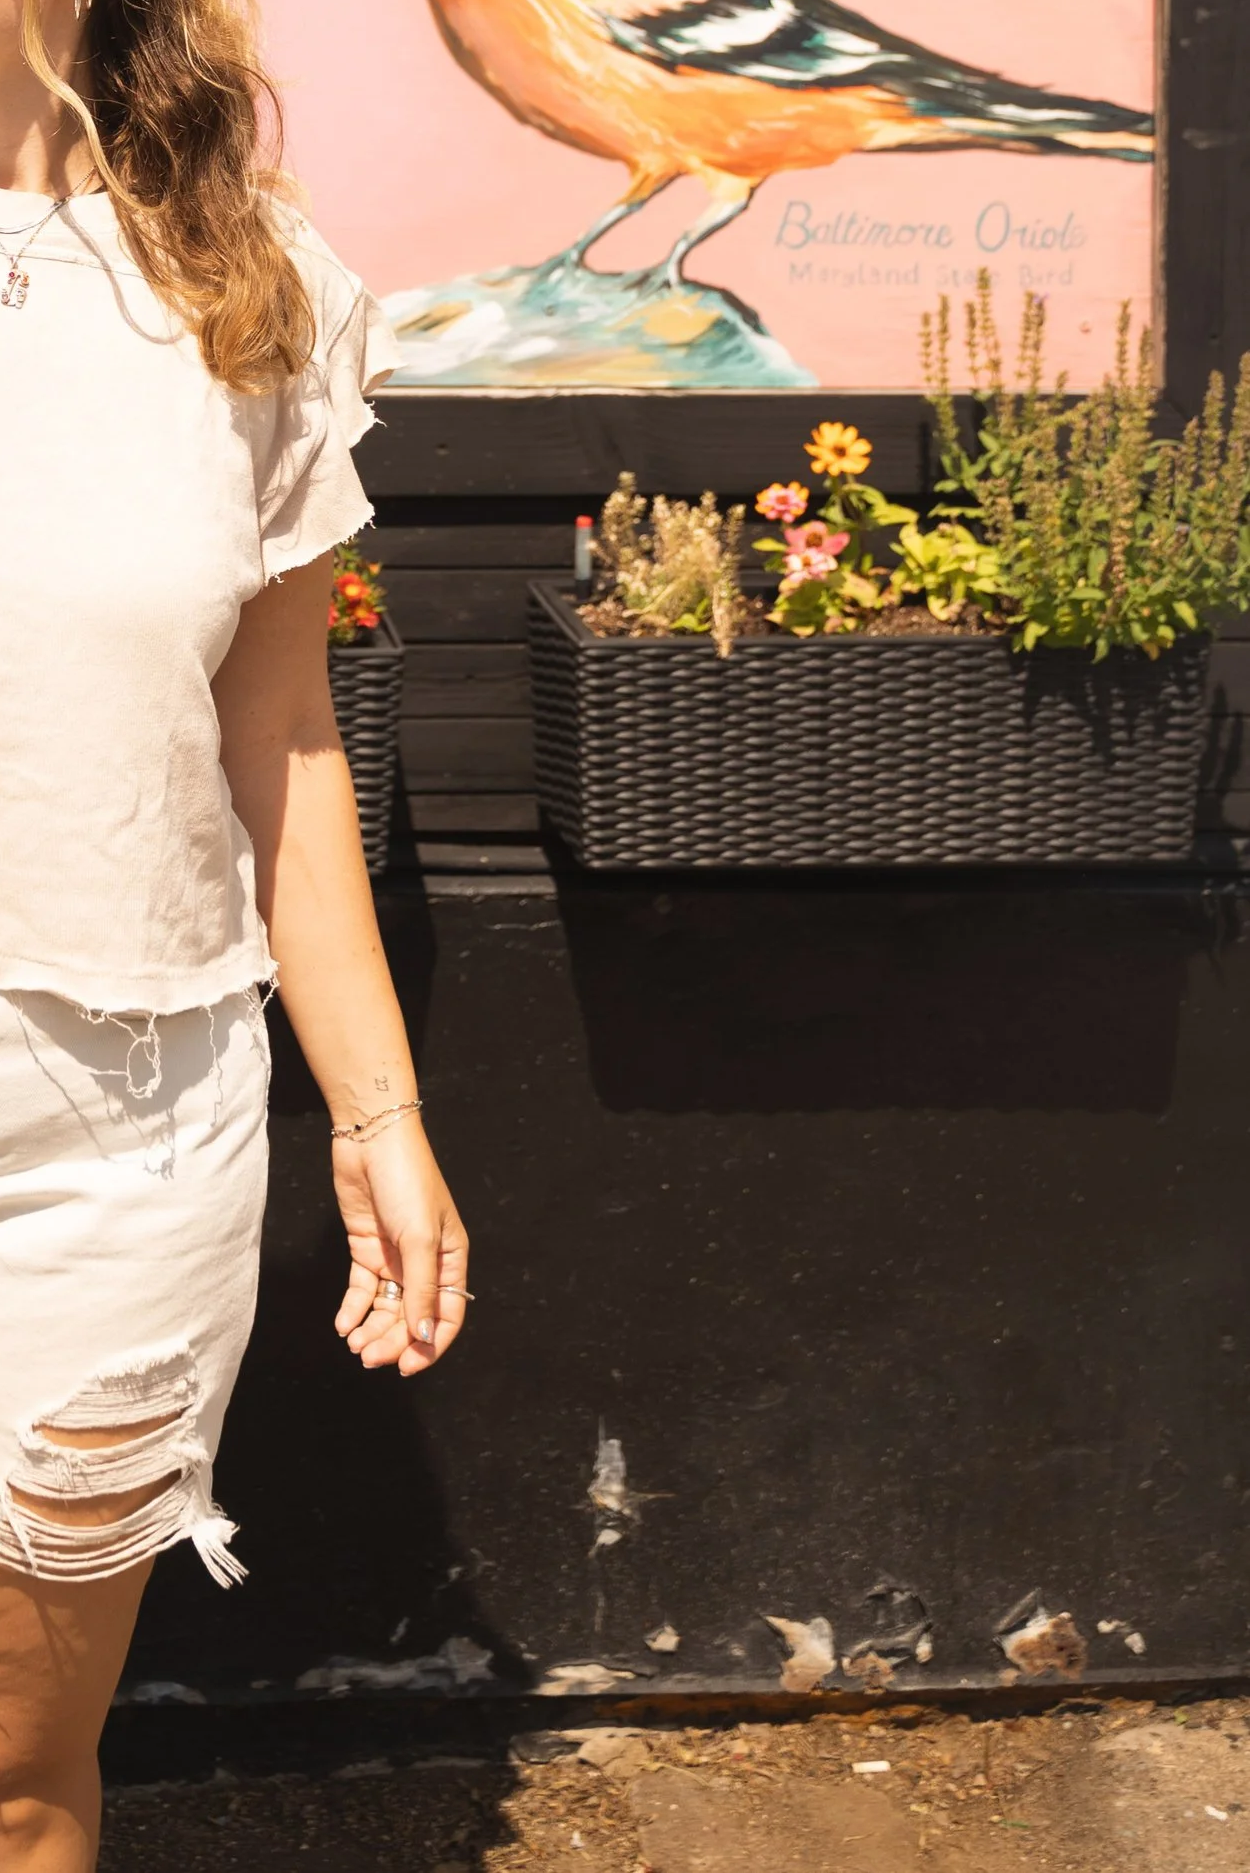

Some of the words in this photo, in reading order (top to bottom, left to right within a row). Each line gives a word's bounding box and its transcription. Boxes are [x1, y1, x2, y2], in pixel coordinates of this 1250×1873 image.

[773, 199, 955, 251] Baltimore
[975, 199, 1087, 253] Oriole
[787, 260, 920, 289] Maryland
[935, 263, 1001, 287] Stae
[1018, 262, 1074, 287] Bird
